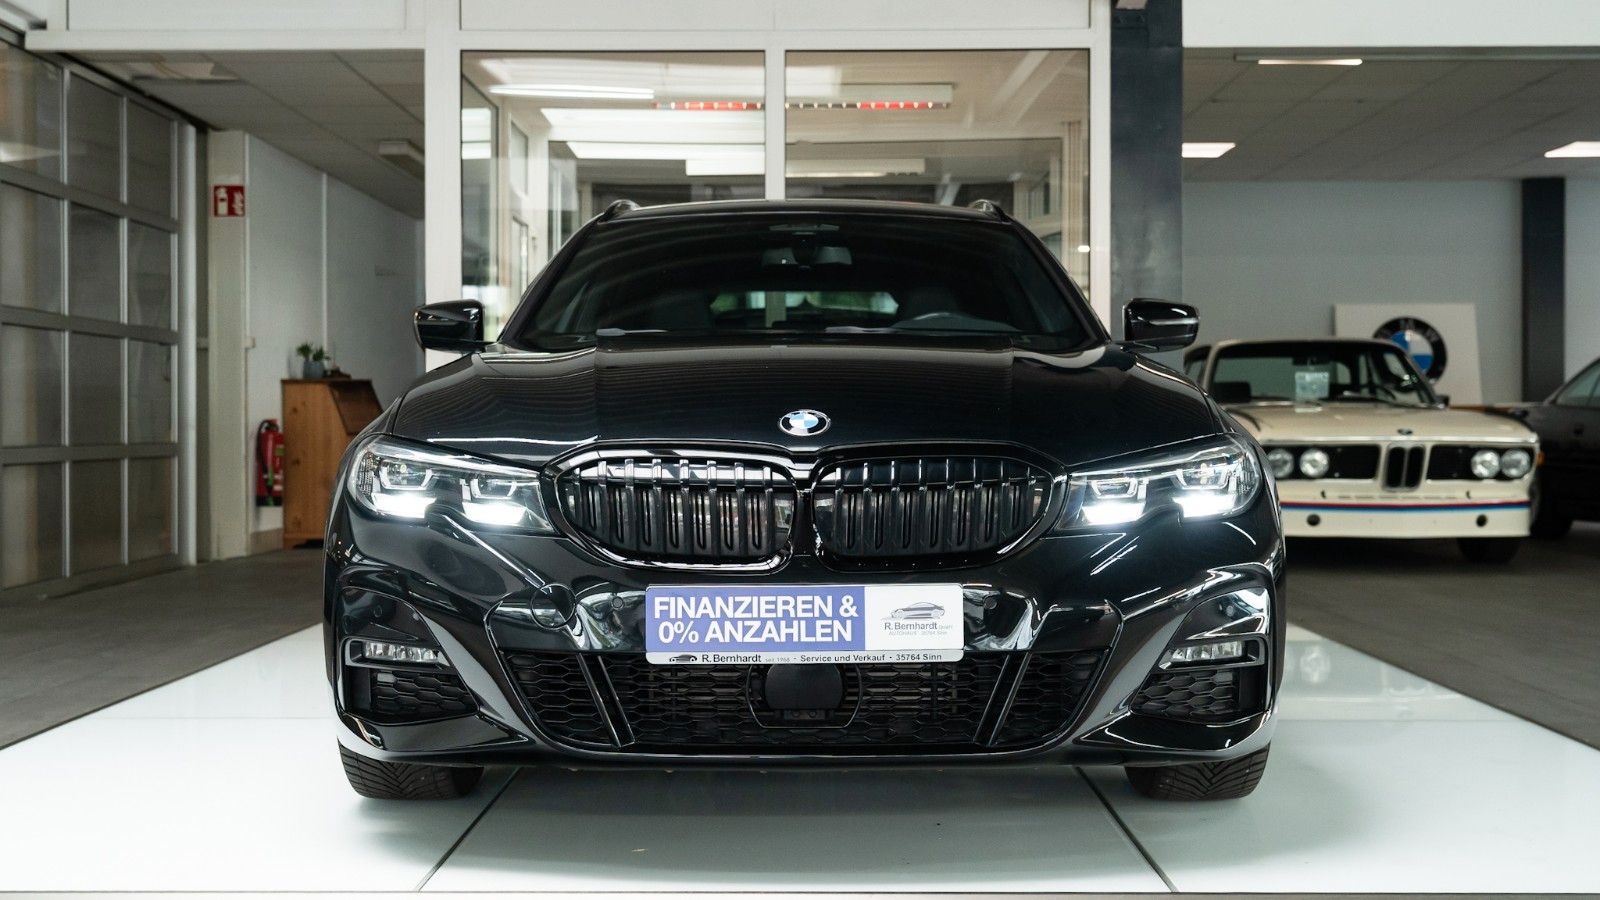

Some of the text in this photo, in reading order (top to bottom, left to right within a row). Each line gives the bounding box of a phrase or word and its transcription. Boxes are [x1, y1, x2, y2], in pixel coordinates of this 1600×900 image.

[654, 595, 859, 619] FINANZIEREN &
[658, 619, 852, 644] 0% ANZAHLEN
[800, 654, 832, 662] Service
[834, 654, 851, 662] und
[895, 653, 921, 661] 35764
[922, 653, 942, 661] Sinn
